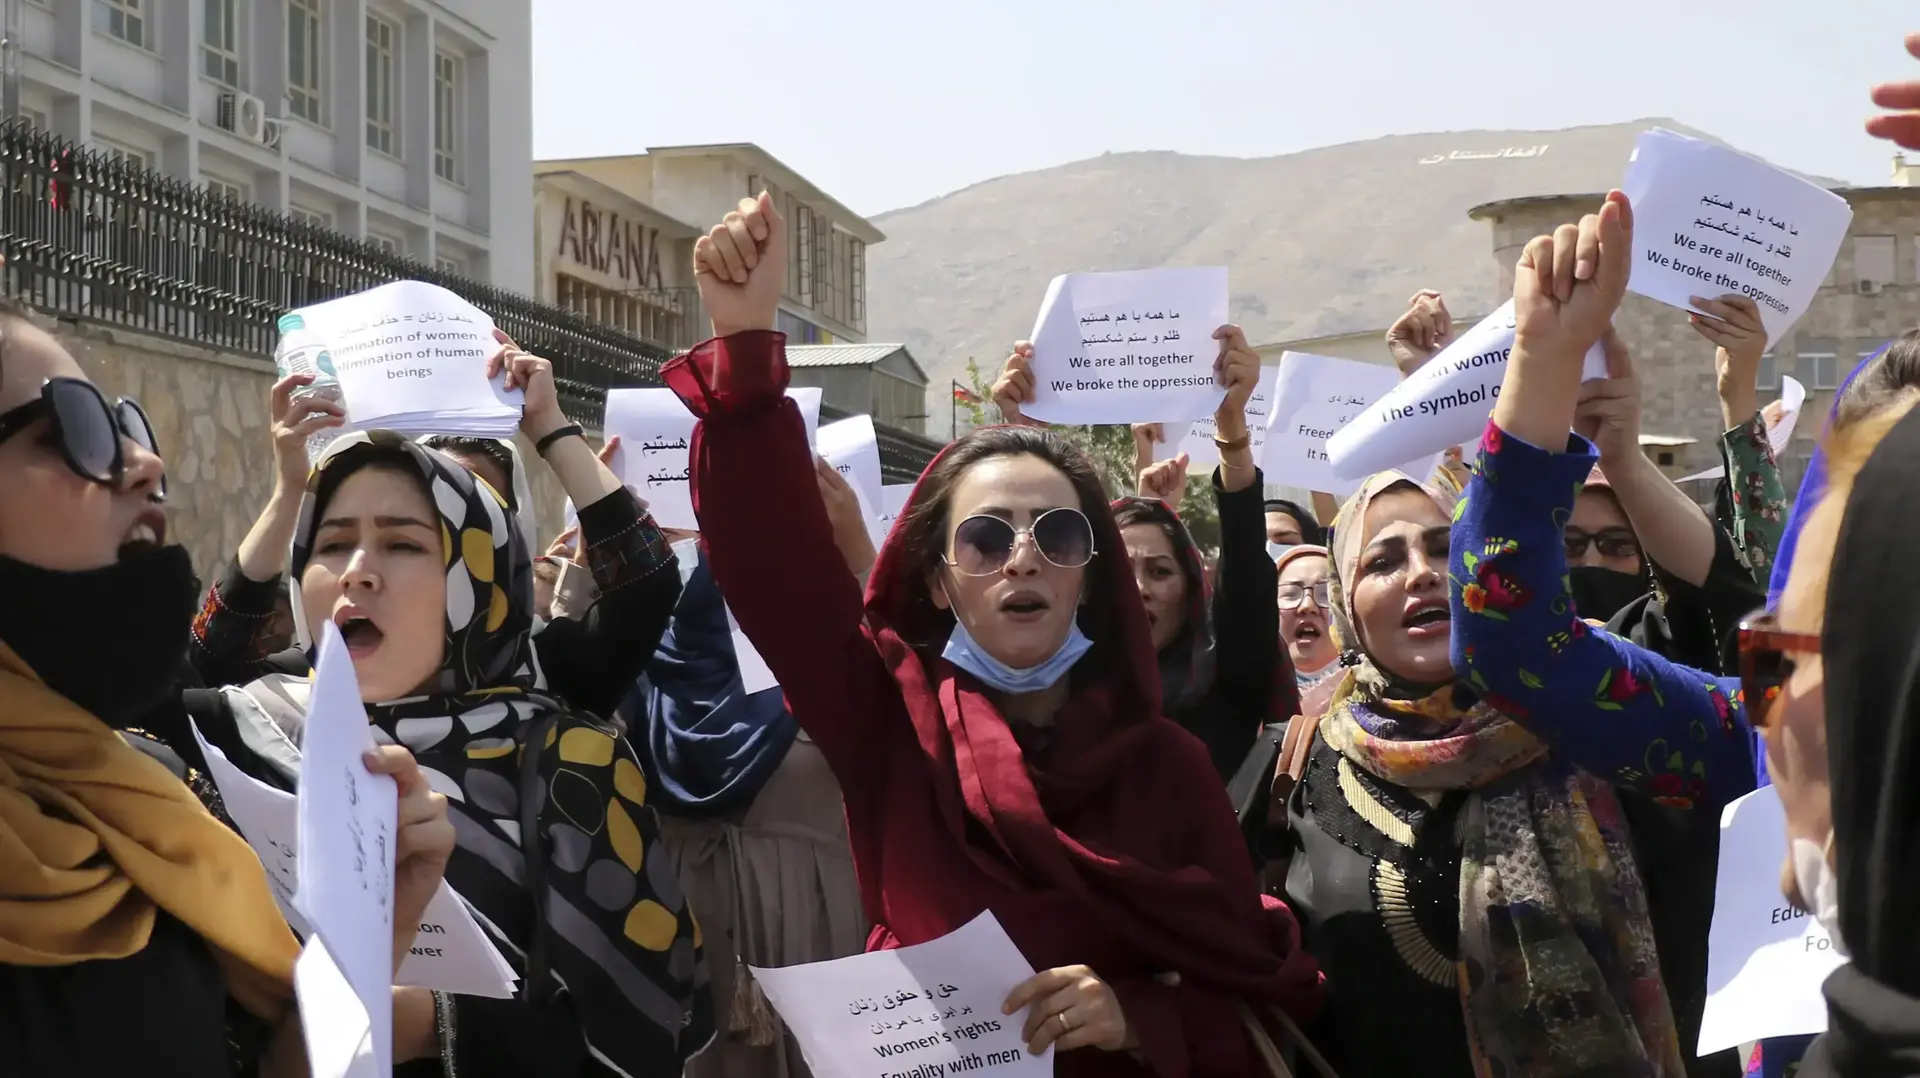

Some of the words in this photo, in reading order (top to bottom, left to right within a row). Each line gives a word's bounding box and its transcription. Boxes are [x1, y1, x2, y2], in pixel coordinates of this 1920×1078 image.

[1418, 144, 1550, 165] افغانستان
[1700, 194, 1734, 210] هستیم
[1736, 207, 1752, 219] هم
[1756, 208, 1766, 224] با
[1693, 216, 1740, 236] شکستیم
[1768, 216, 1786, 231] همه
[1789, 222, 1799, 236] ما
[558, 196, 663, 293] ARIANA
[1742, 232, 1763, 246] ستم
[1765, 244, 1774, 253] و
[1775, 244, 1792, 259] ظلم
[1674, 232, 1697, 250] We
[1699, 244, 1723, 258] are
[1726, 251, 1744, 265] all
[1746, 257, 1792, 287] together
[1646, 249, 1669, 267] We
[1672, 258, 1712, 282] broke
[1715, 273, 1739, 290] the
[1742, 284, 1790, 315] oppression
[418, 311, 444, 324] زنان
[1080, 312, 1110, 327] هستیم
[1115, 313, 1128, 326] هم
[1132, 310, 1141, 323] با
[1144, 312, 1164, 320] همه
[1168, 309, 1180, 319] ما
[333, 334, 403, 358] limination
[407, 330, 422, 342] of
[425, 332, 478, 341] women
[1082, 331, 1124, 348] شکستیم
[1127, 332, 1147, 346] ستم
[1151, 334, 1159, 344] و
[1162, 329, 1180, 344] ظلم
[416, 347, 432, 360] of
[435, 347, 485, 358] human
[1069, 357, 1091, 368] We
[1095, 357, 1115, 367] are
[1119, 354, 1134, 366] all
[1138, 353, 1194, 368] together
[1453, 347, 1511, 372] wome
[386, 366, 433, 380] beings
[1051, 380, 1073, 391] We
[1076, 377, 1114, 391] broke
[1118, 377, 1139, 389] the
[1143, 374, 1214, 390] oppression
[1419, 384, 1487, 416] symbol
[1491, 384, 1502, 398] o
[1298, 424, 1334, 440] Freed
[642, 435, 688, 459] هستیم
[647, 467, 690, 490] کستیم
[1771, 903, 1805, 925] Edu
[925, 989, 934, 1000] و
[937, 983, 959, 998] حق
[848, 998, 879, 1016] زنان
[882, 989, 919, 1010] حقوق
[873, 1031, 952, 1058] Women's
[954, 1018, 1001, 1041] rights
[948, 1052, 984, 1074] with
[987, 1047, 1021, 1067] men
